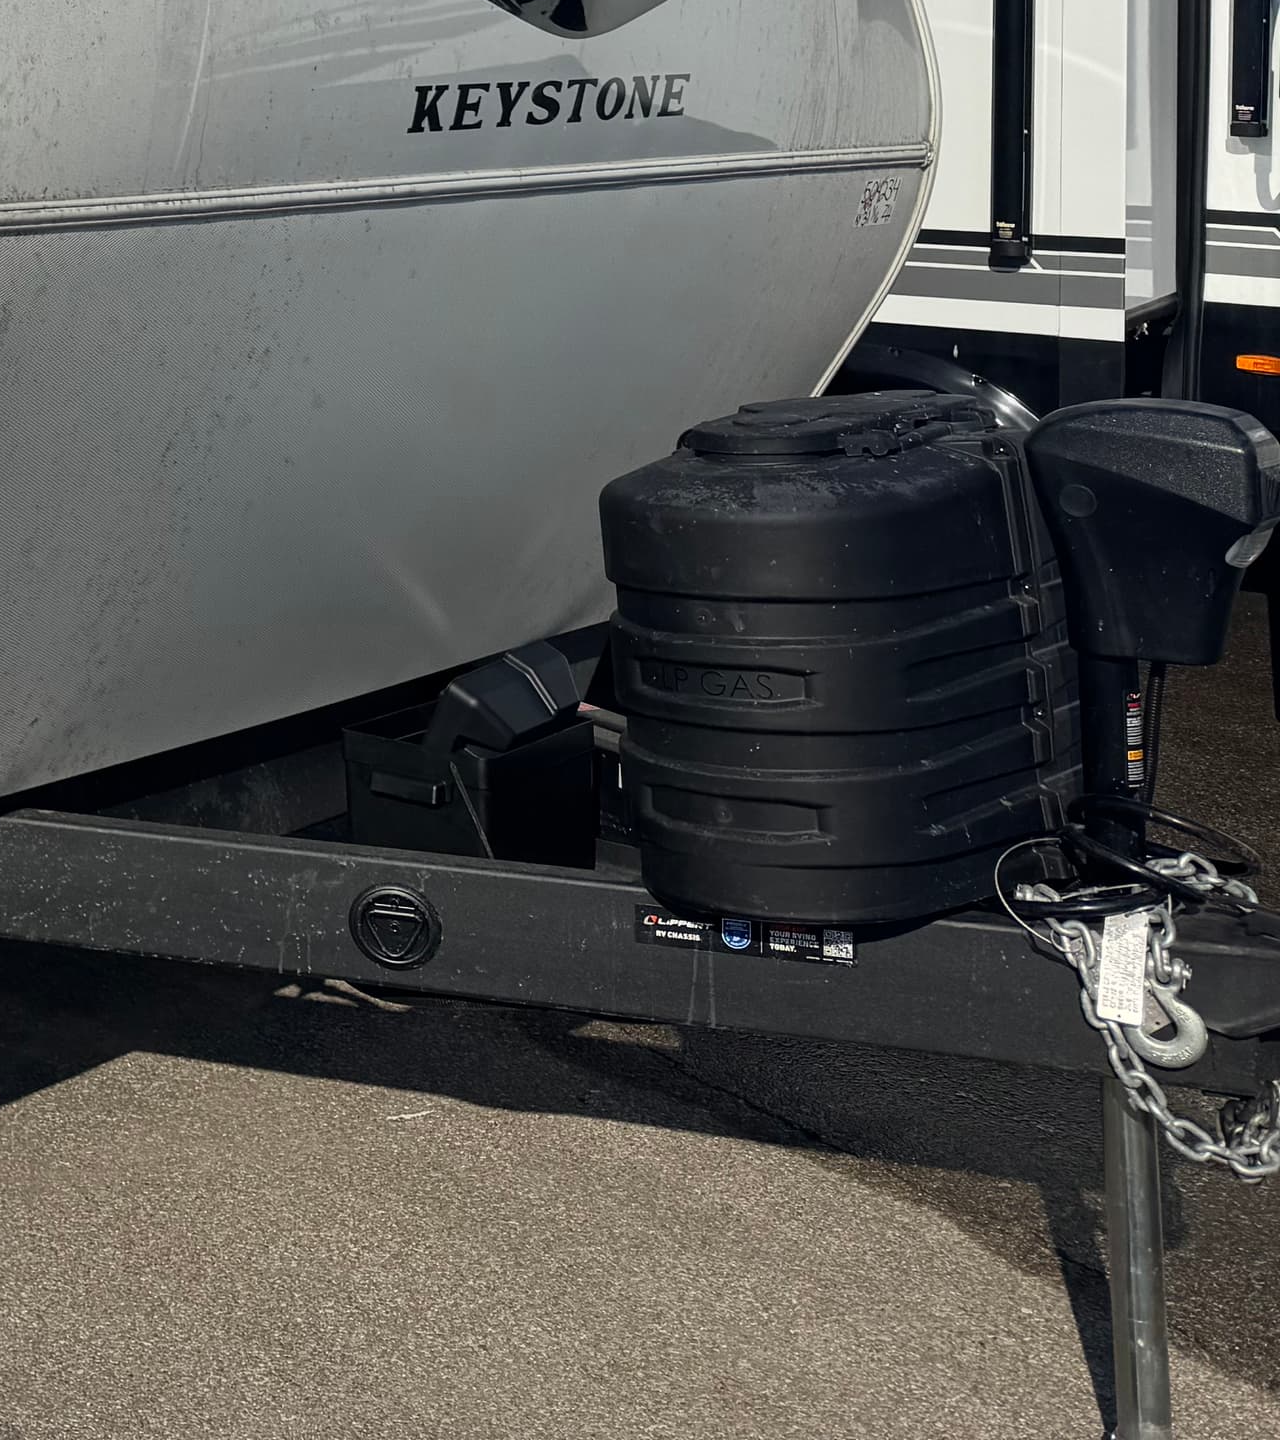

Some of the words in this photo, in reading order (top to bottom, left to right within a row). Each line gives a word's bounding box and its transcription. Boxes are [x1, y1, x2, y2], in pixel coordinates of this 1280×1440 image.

[406, 72, 692, 134] KEYSTONE
[661, 666, 689, 692] LP
[700, 671, 774, 699] GAS
[657, 916, 714, 930] LIPPERT
[655, 929, 667, 938] RV
[667, 930, 702, 942] CHASSIS
[769, 929, 791, 938] YOUR
